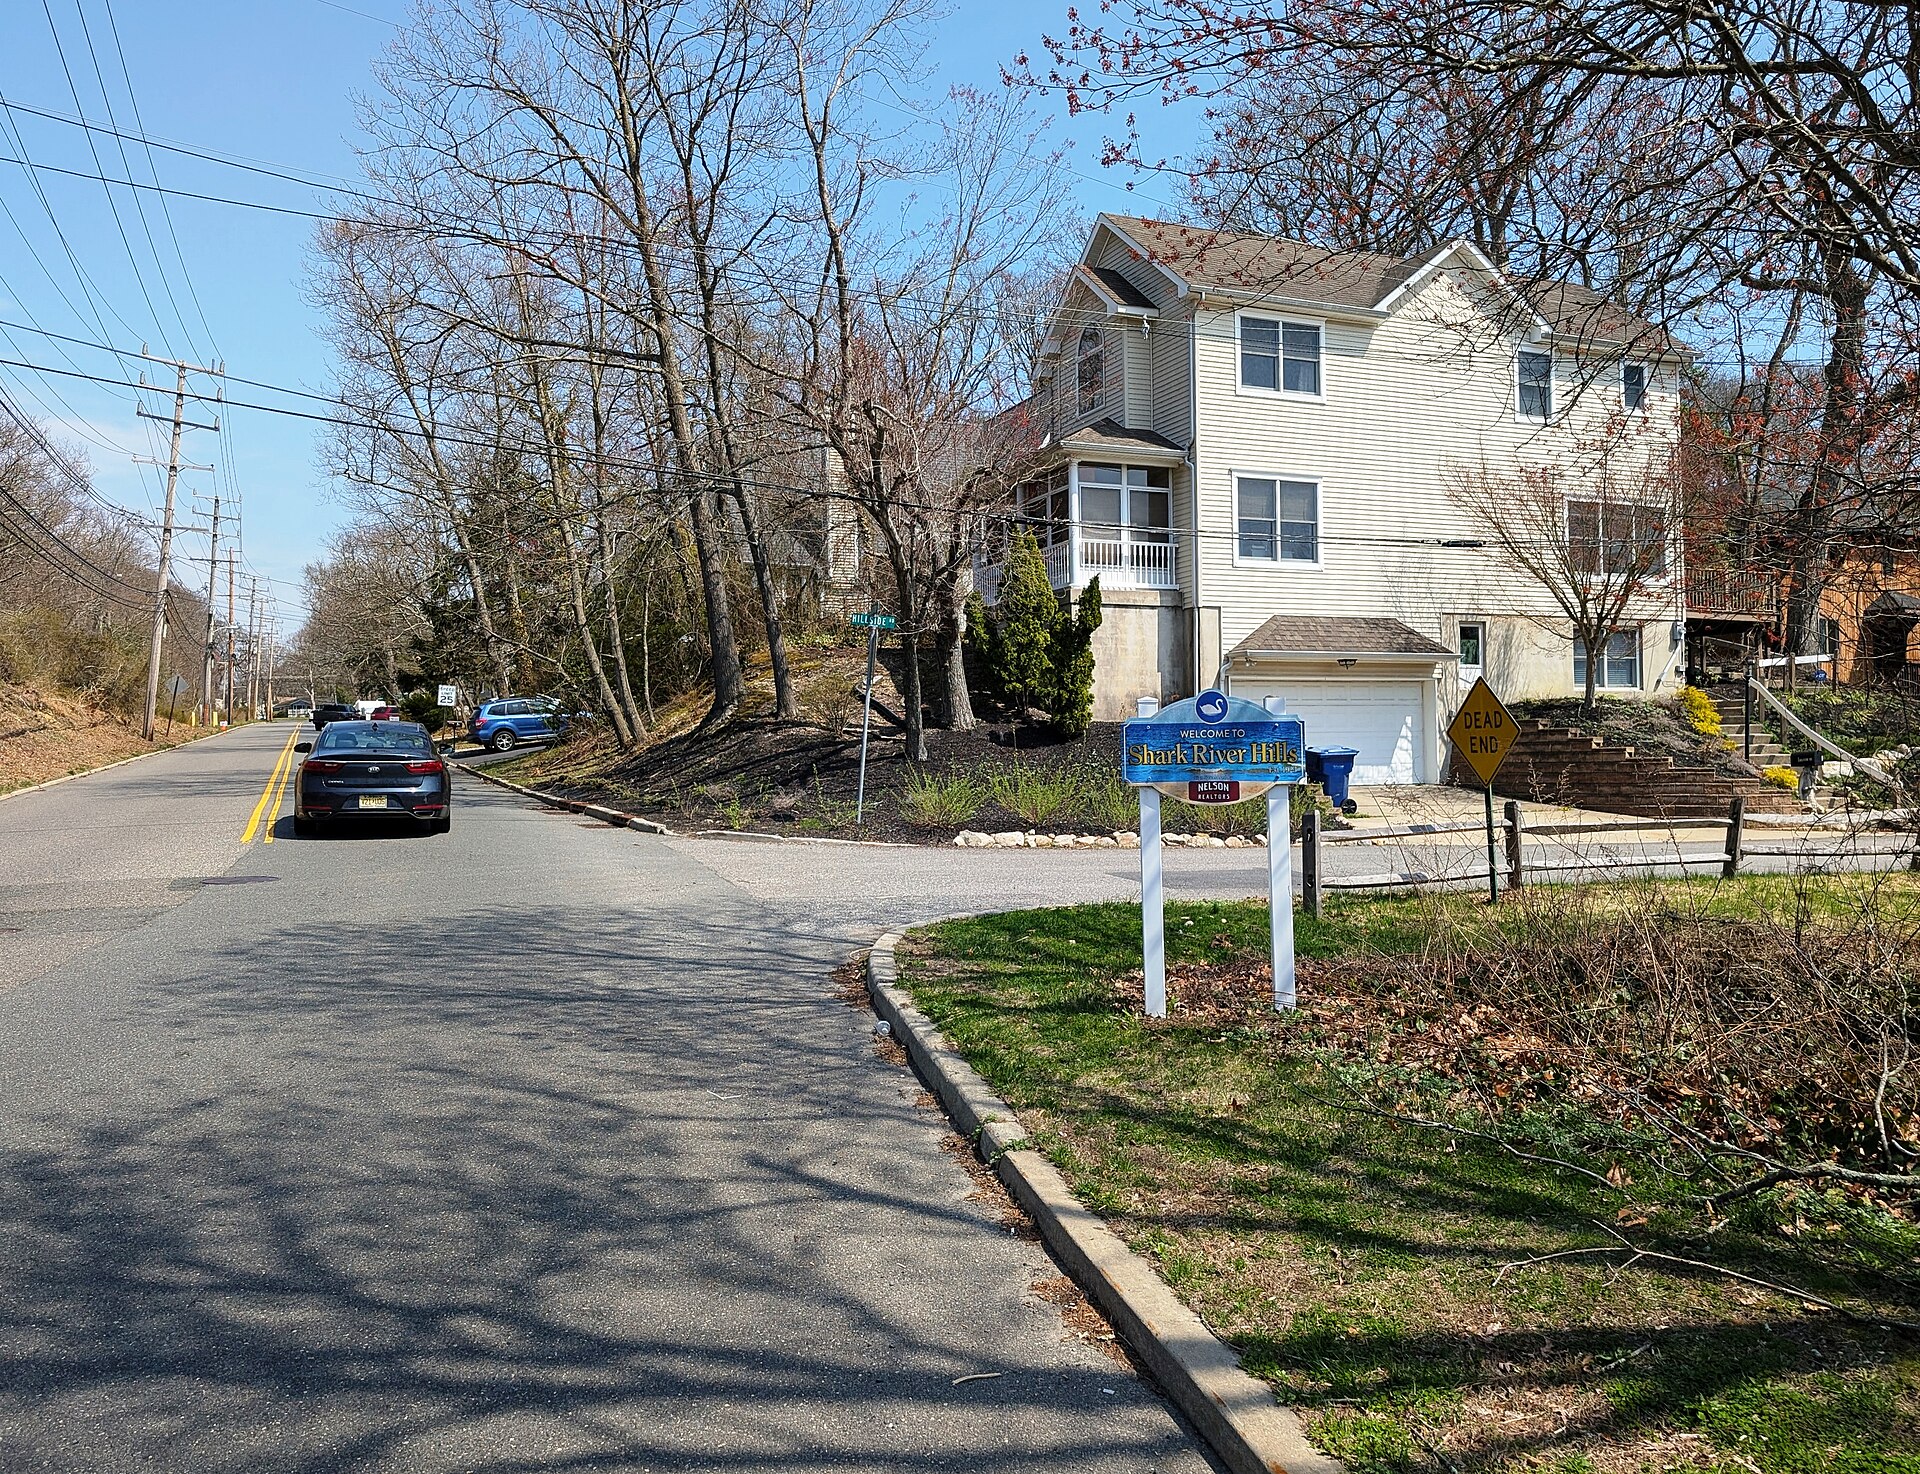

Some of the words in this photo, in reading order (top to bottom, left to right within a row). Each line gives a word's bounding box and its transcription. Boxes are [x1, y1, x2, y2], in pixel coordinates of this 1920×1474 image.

[852, 614, 886, 626] HILLSIDE
[440, 695, 454, 704] 25
[1463, 710, 1503, 730] DEAD
[1179, 729, 1230, 739] WELCOME
[1232, 728, 1246, 738] TO
[1469, 735, 1499, 754] END
[1128, 742, 1189, 766] Shark
[1192, 743, 1247, 765] River
[1250, 741, 1299, 764] Hills
[1197, 781, 1230, 792] NELSON
